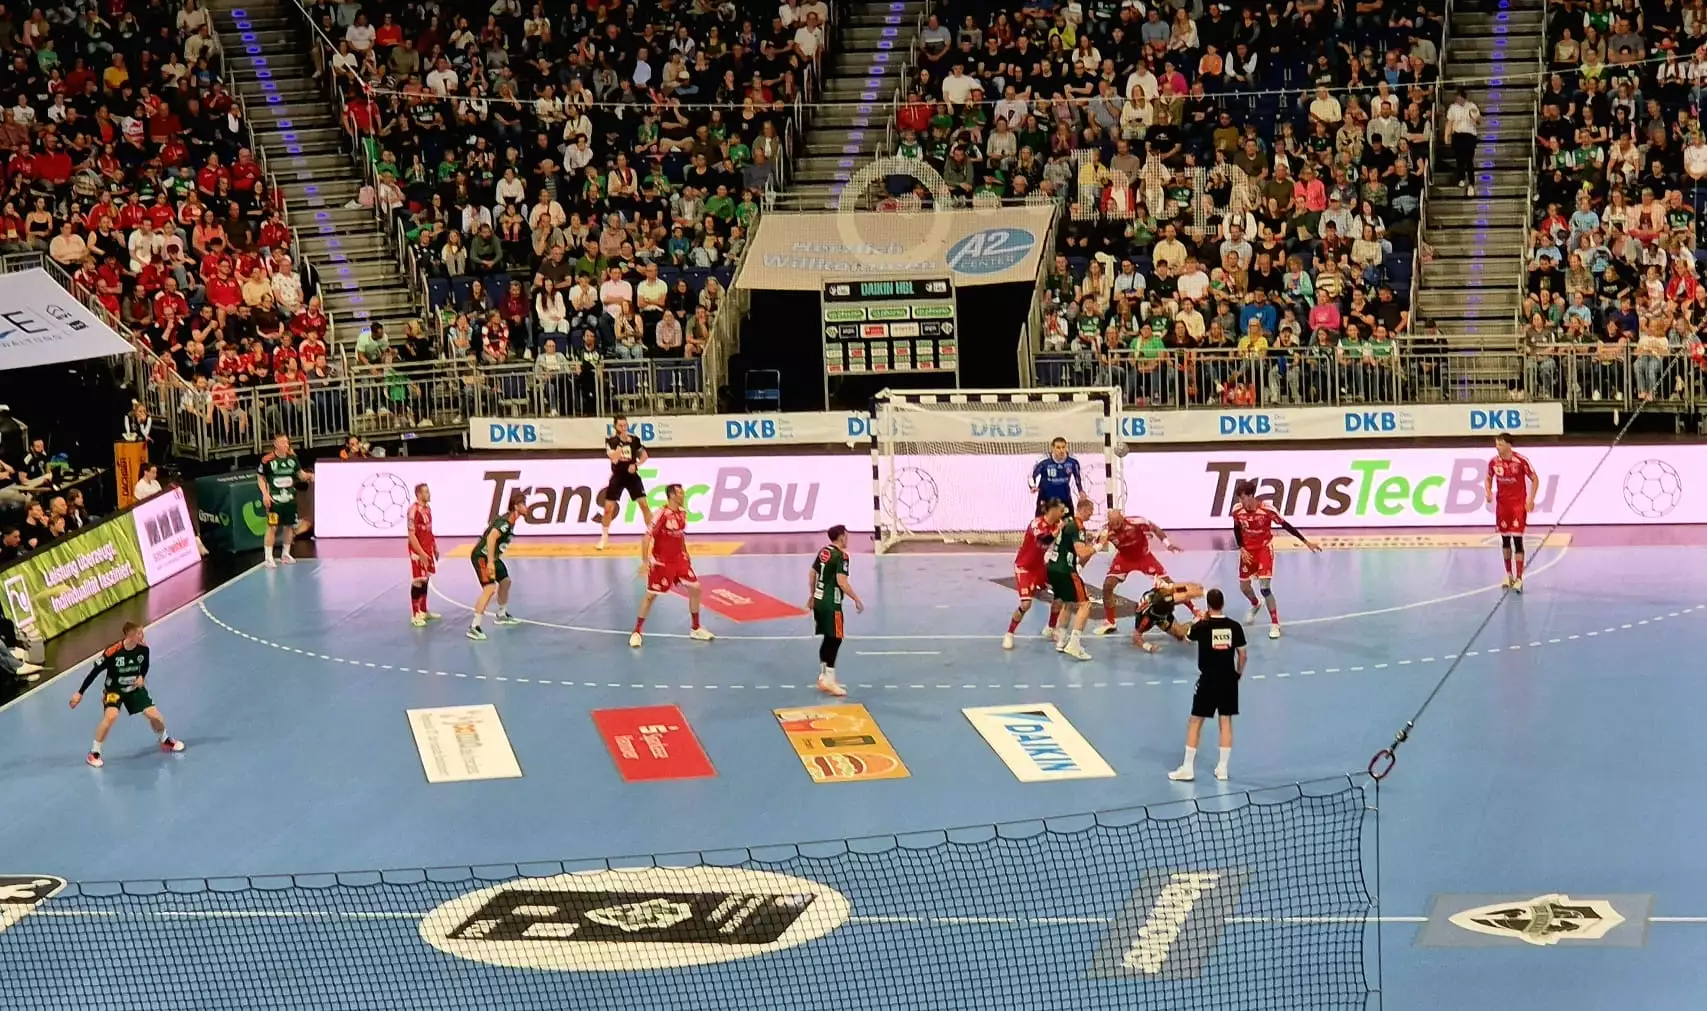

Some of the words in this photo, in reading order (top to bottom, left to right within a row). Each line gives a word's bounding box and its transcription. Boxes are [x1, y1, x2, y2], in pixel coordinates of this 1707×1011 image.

[952, 231, 1024, 263] A2
[726, 420, 776, 439] DKB
[1219, 415, 1271, 435] DKB
[1344, 412, 1396, 432] DKB
[1469, 409, 1521, 430] DKB
[490, 424, 536, 443] DKB
[1005, 723, 1083, 773] DAIKIN
